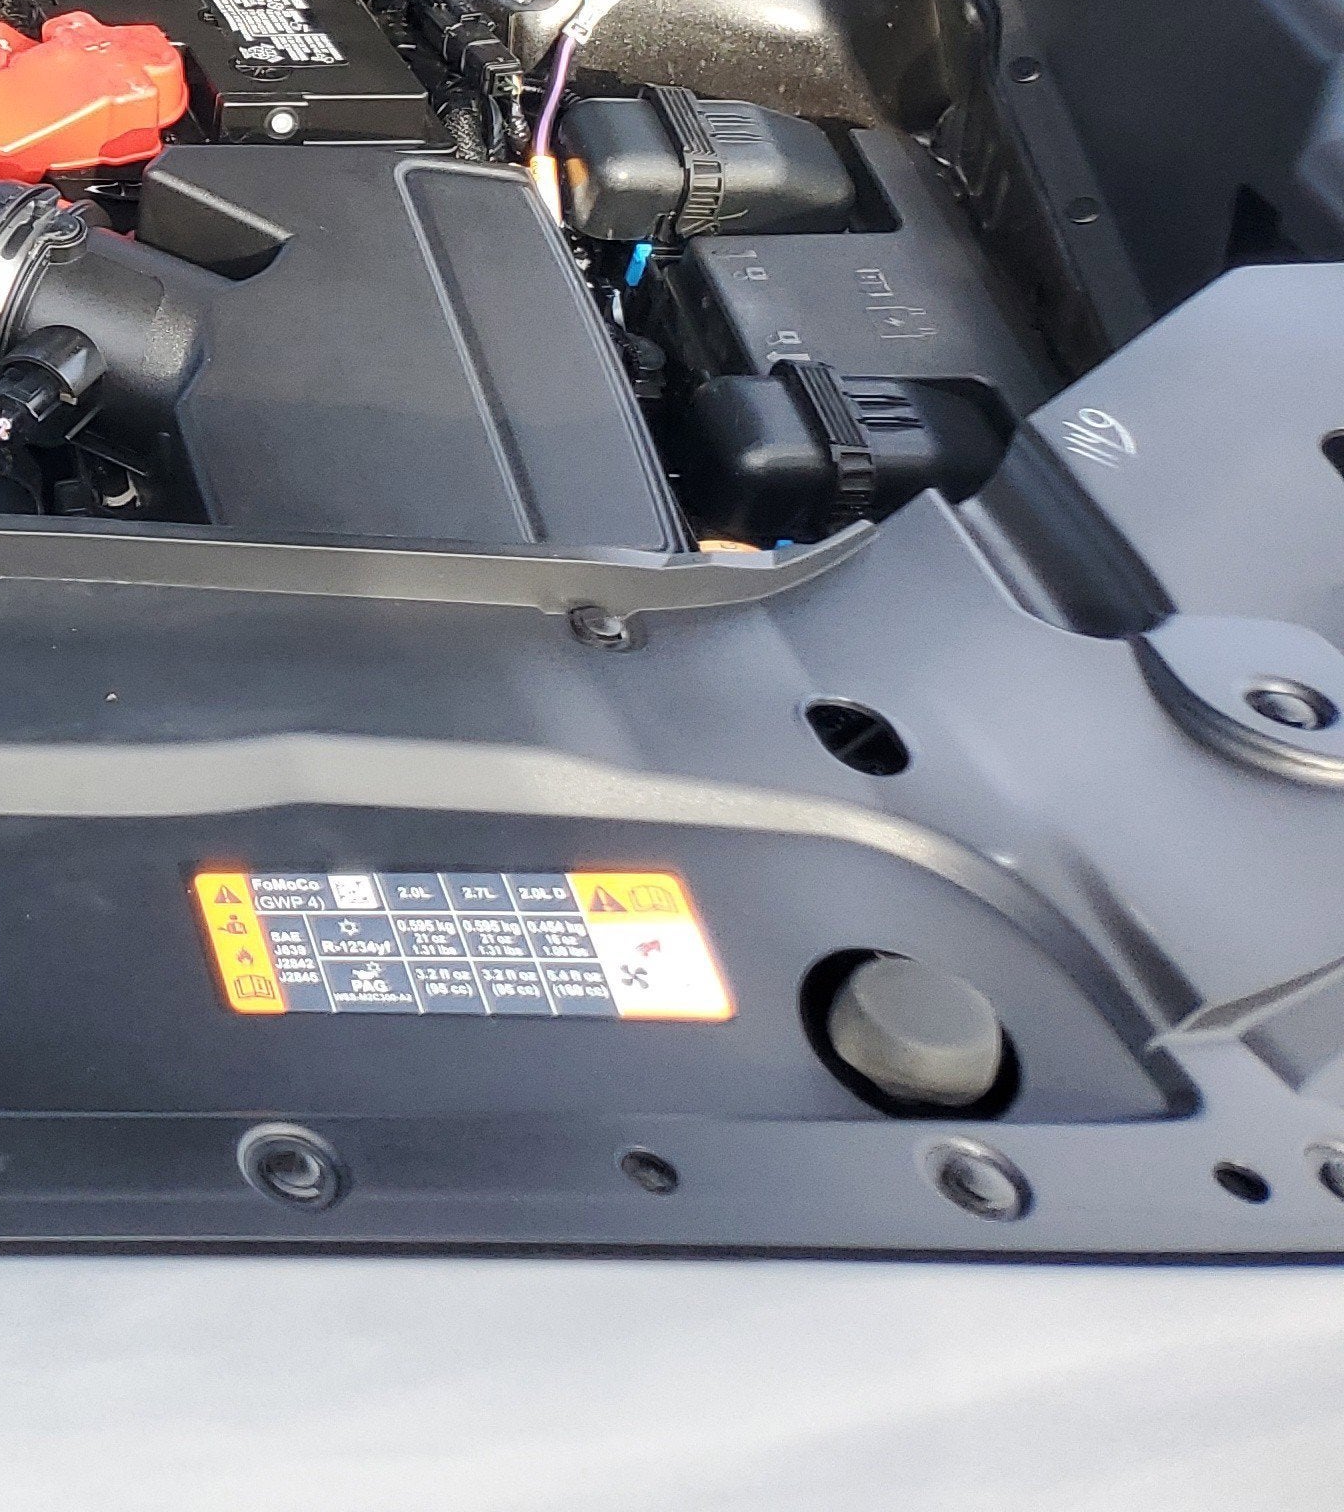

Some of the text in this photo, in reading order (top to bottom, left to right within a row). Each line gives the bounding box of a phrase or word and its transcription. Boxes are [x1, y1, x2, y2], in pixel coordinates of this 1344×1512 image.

[251, 877, 320, 891] FoMoCo
[462, 886, 499, 899] 2.7L
[254, 895, 326, 911] (GWP 4)
[415, 968, 438, 981] 3.2
[452, 970, 472, 981] oz
[481, 968, 504, 981] 3.2
[518, 971, 539, 982] oz
[351, 979, 389, 993] PAG
